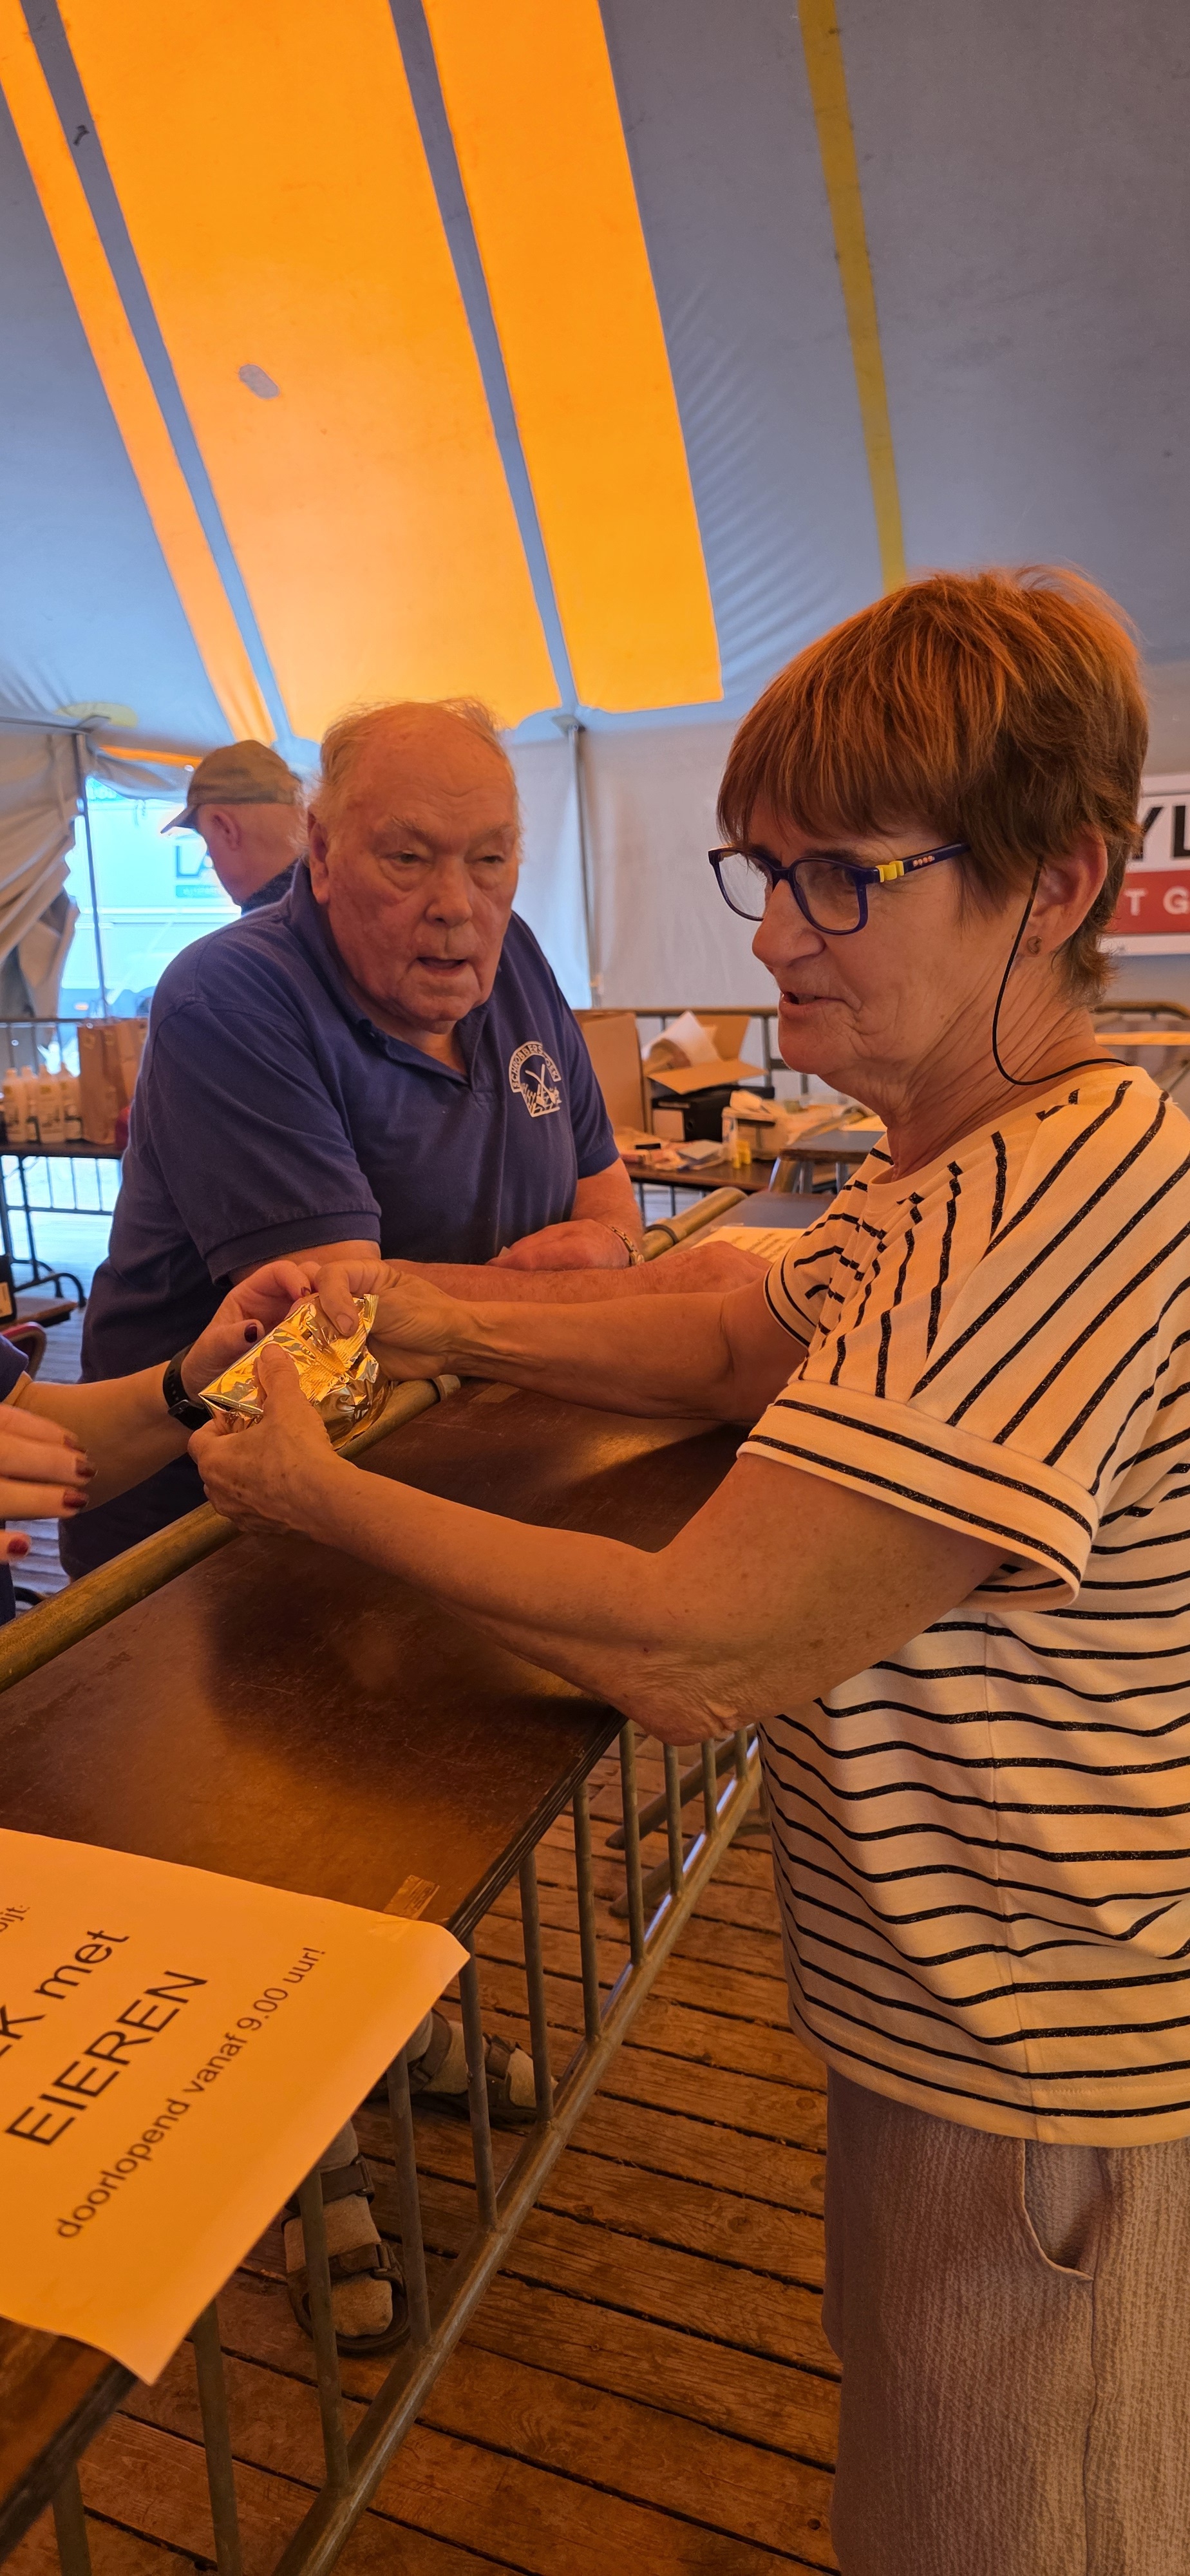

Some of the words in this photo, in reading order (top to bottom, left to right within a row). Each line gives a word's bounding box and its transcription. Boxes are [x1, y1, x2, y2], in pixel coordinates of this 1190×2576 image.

[33, 1929, 130, 2000] met
[3, 1969, 209, 2147] EIEREN
[57, 2097, 191, 2239] doorlopend
[182, 2031, 249, 2094] vanaf
[236, 1987, 289, 2031] 9.00
[282, 1947, 326, 1984] uur!
